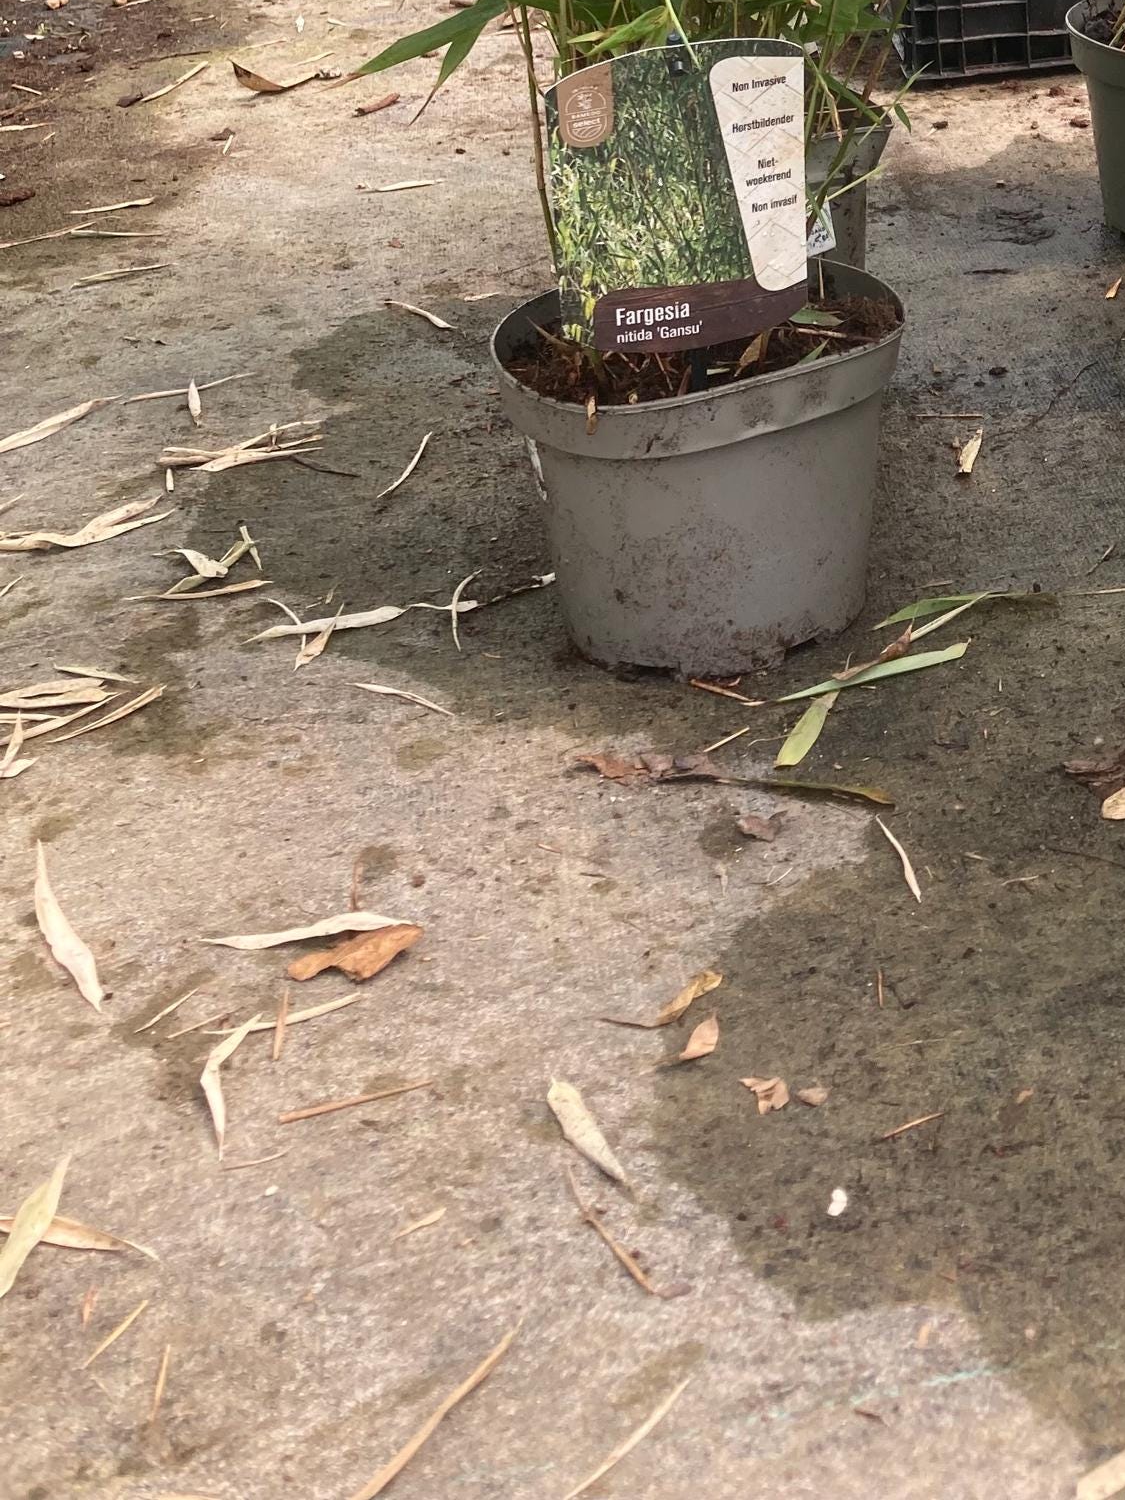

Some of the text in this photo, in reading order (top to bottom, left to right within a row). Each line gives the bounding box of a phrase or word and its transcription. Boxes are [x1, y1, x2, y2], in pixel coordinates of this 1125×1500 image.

[732, 75, 786, 92] Non Invasive
[732, 114, 794, 133] Horstbildender
[758, 157, 779, 170] Niet-
[746, 169, 791, 187] woekerend
[752, 194, 798, 213] Non invasif
[616, 301, 690, 326] Fargesia
[617, 320, 703, 344] nitida 'Gansu'
